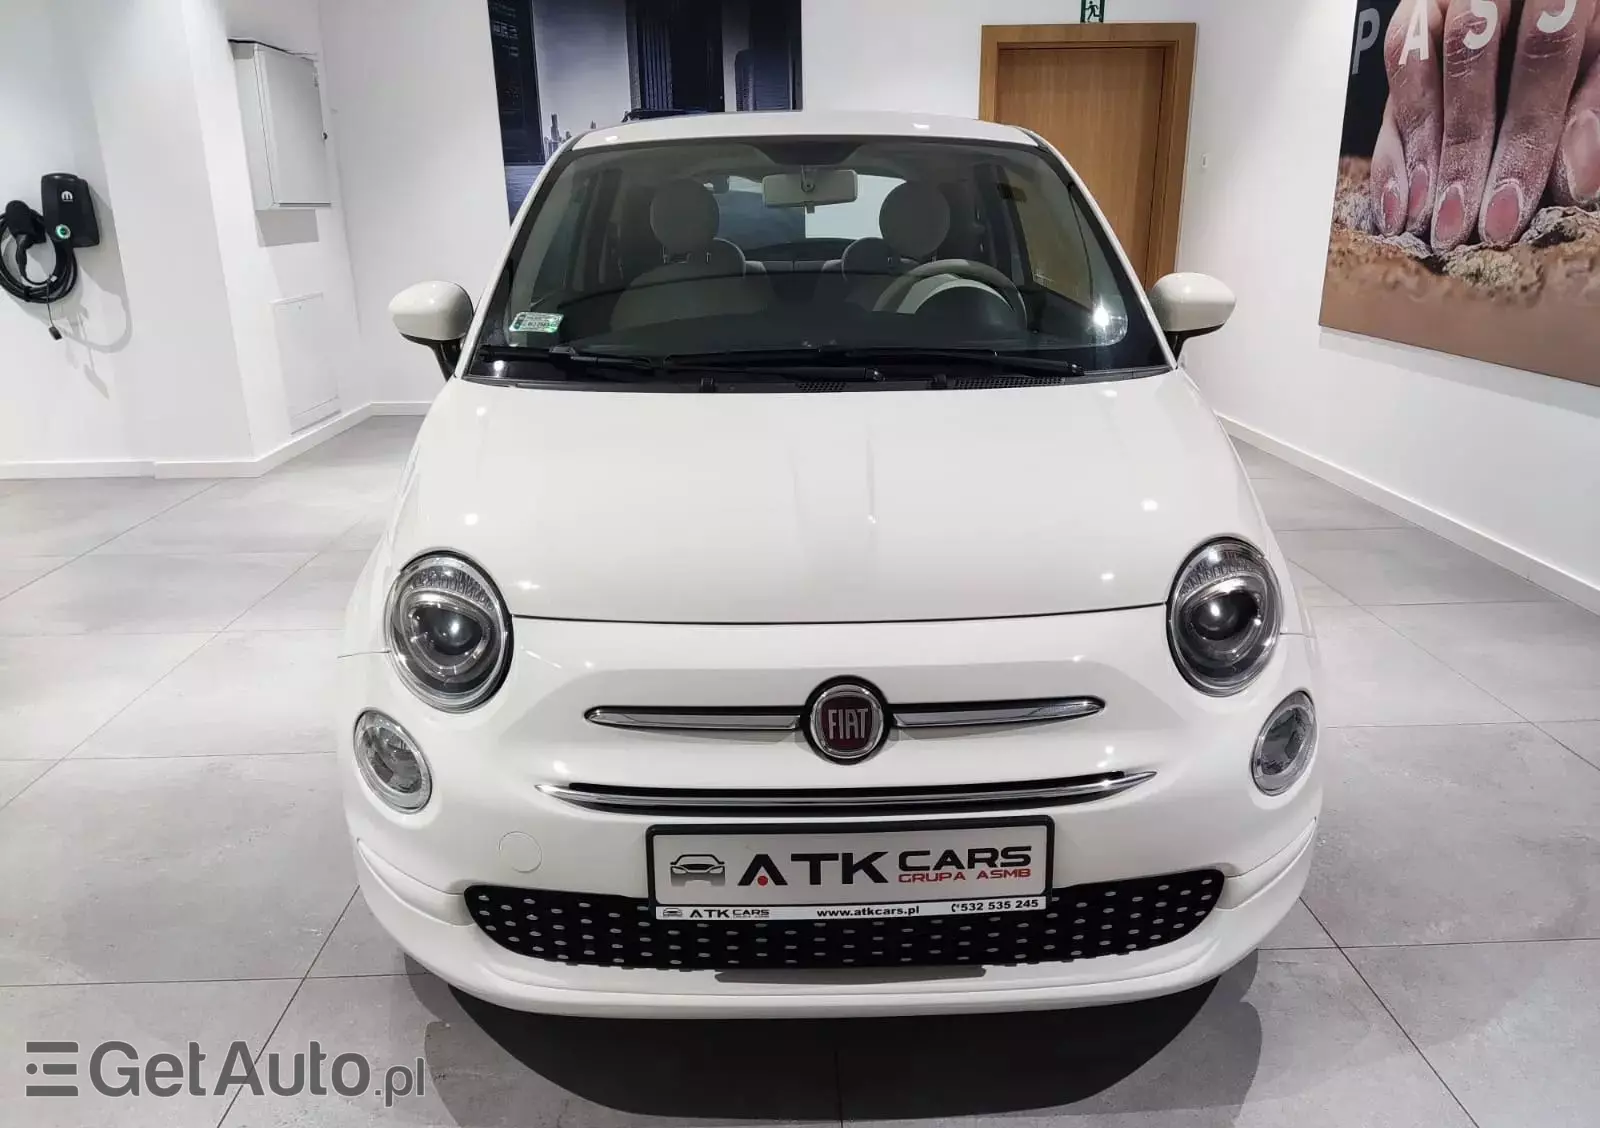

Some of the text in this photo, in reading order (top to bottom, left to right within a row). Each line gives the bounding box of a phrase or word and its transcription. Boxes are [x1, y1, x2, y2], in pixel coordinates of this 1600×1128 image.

[828, 708, 869, 740] FIAT
[737, 846, 1032, 887] ATK CARS
[898, 868, 1031, 883] GRUPA ASMB
[816, 905, 920, 917] www.atkcars.pl
[960, 899, 1039, 912] 532 535 245
[689, 909, 730, 918] ATK
